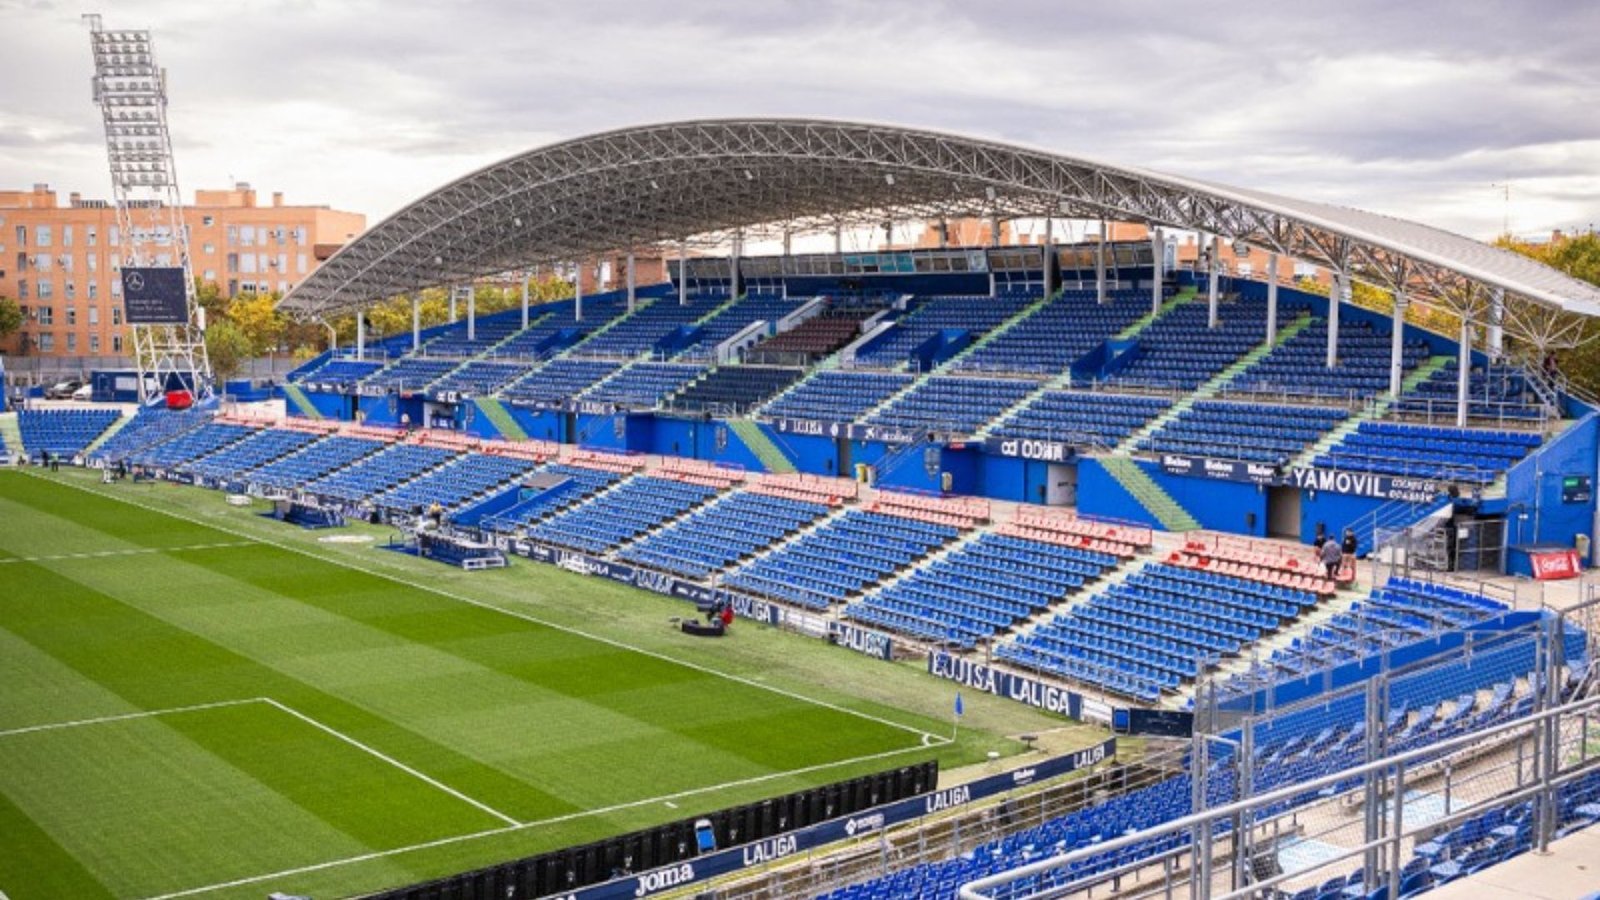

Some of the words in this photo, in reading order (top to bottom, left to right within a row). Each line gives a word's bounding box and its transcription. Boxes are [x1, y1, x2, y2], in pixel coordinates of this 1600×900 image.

[1293, 468, 1386, 497] YAMOVIL
[1009, 675, 1070, 715] LALIGA
[925, 785, 970, 813] LALIGA
[743, 835, 797, 866] LALIGA
